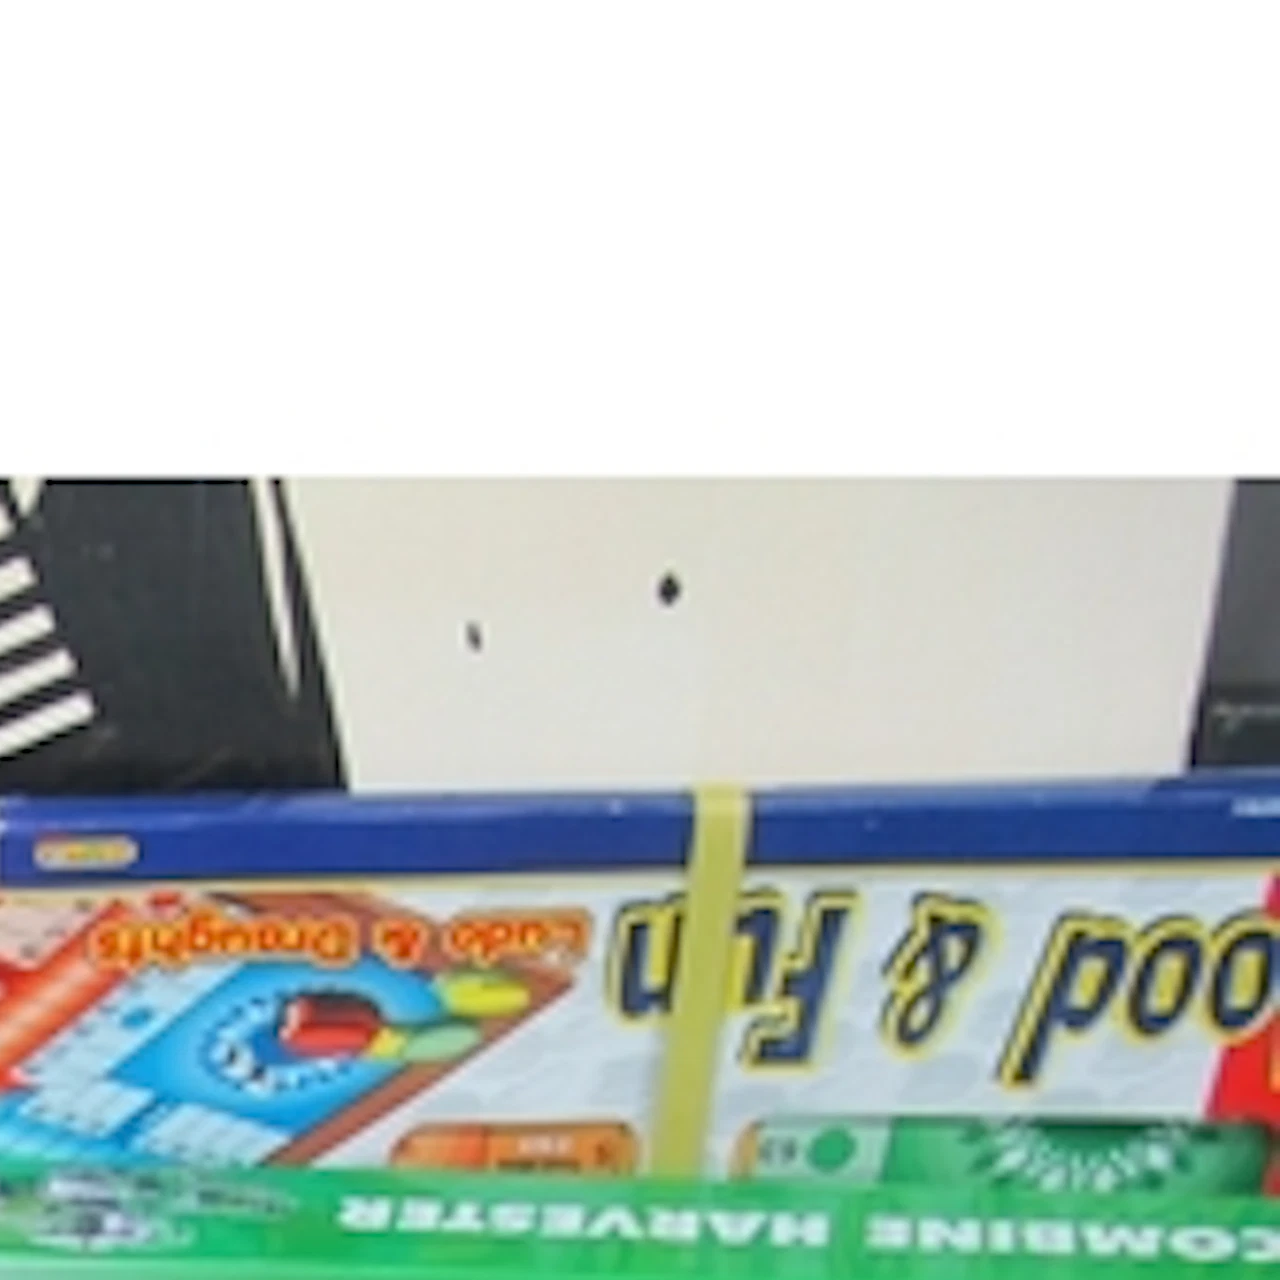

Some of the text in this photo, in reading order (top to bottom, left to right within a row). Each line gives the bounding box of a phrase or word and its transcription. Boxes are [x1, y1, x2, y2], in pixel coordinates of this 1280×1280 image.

[85, 908, 359, 976] Draughts
[874, 893, 985, 1056] &
[997, 912, 1280, 1092] ood
[333, 1193, 1280, 1264] COMBINE HARVESTER
